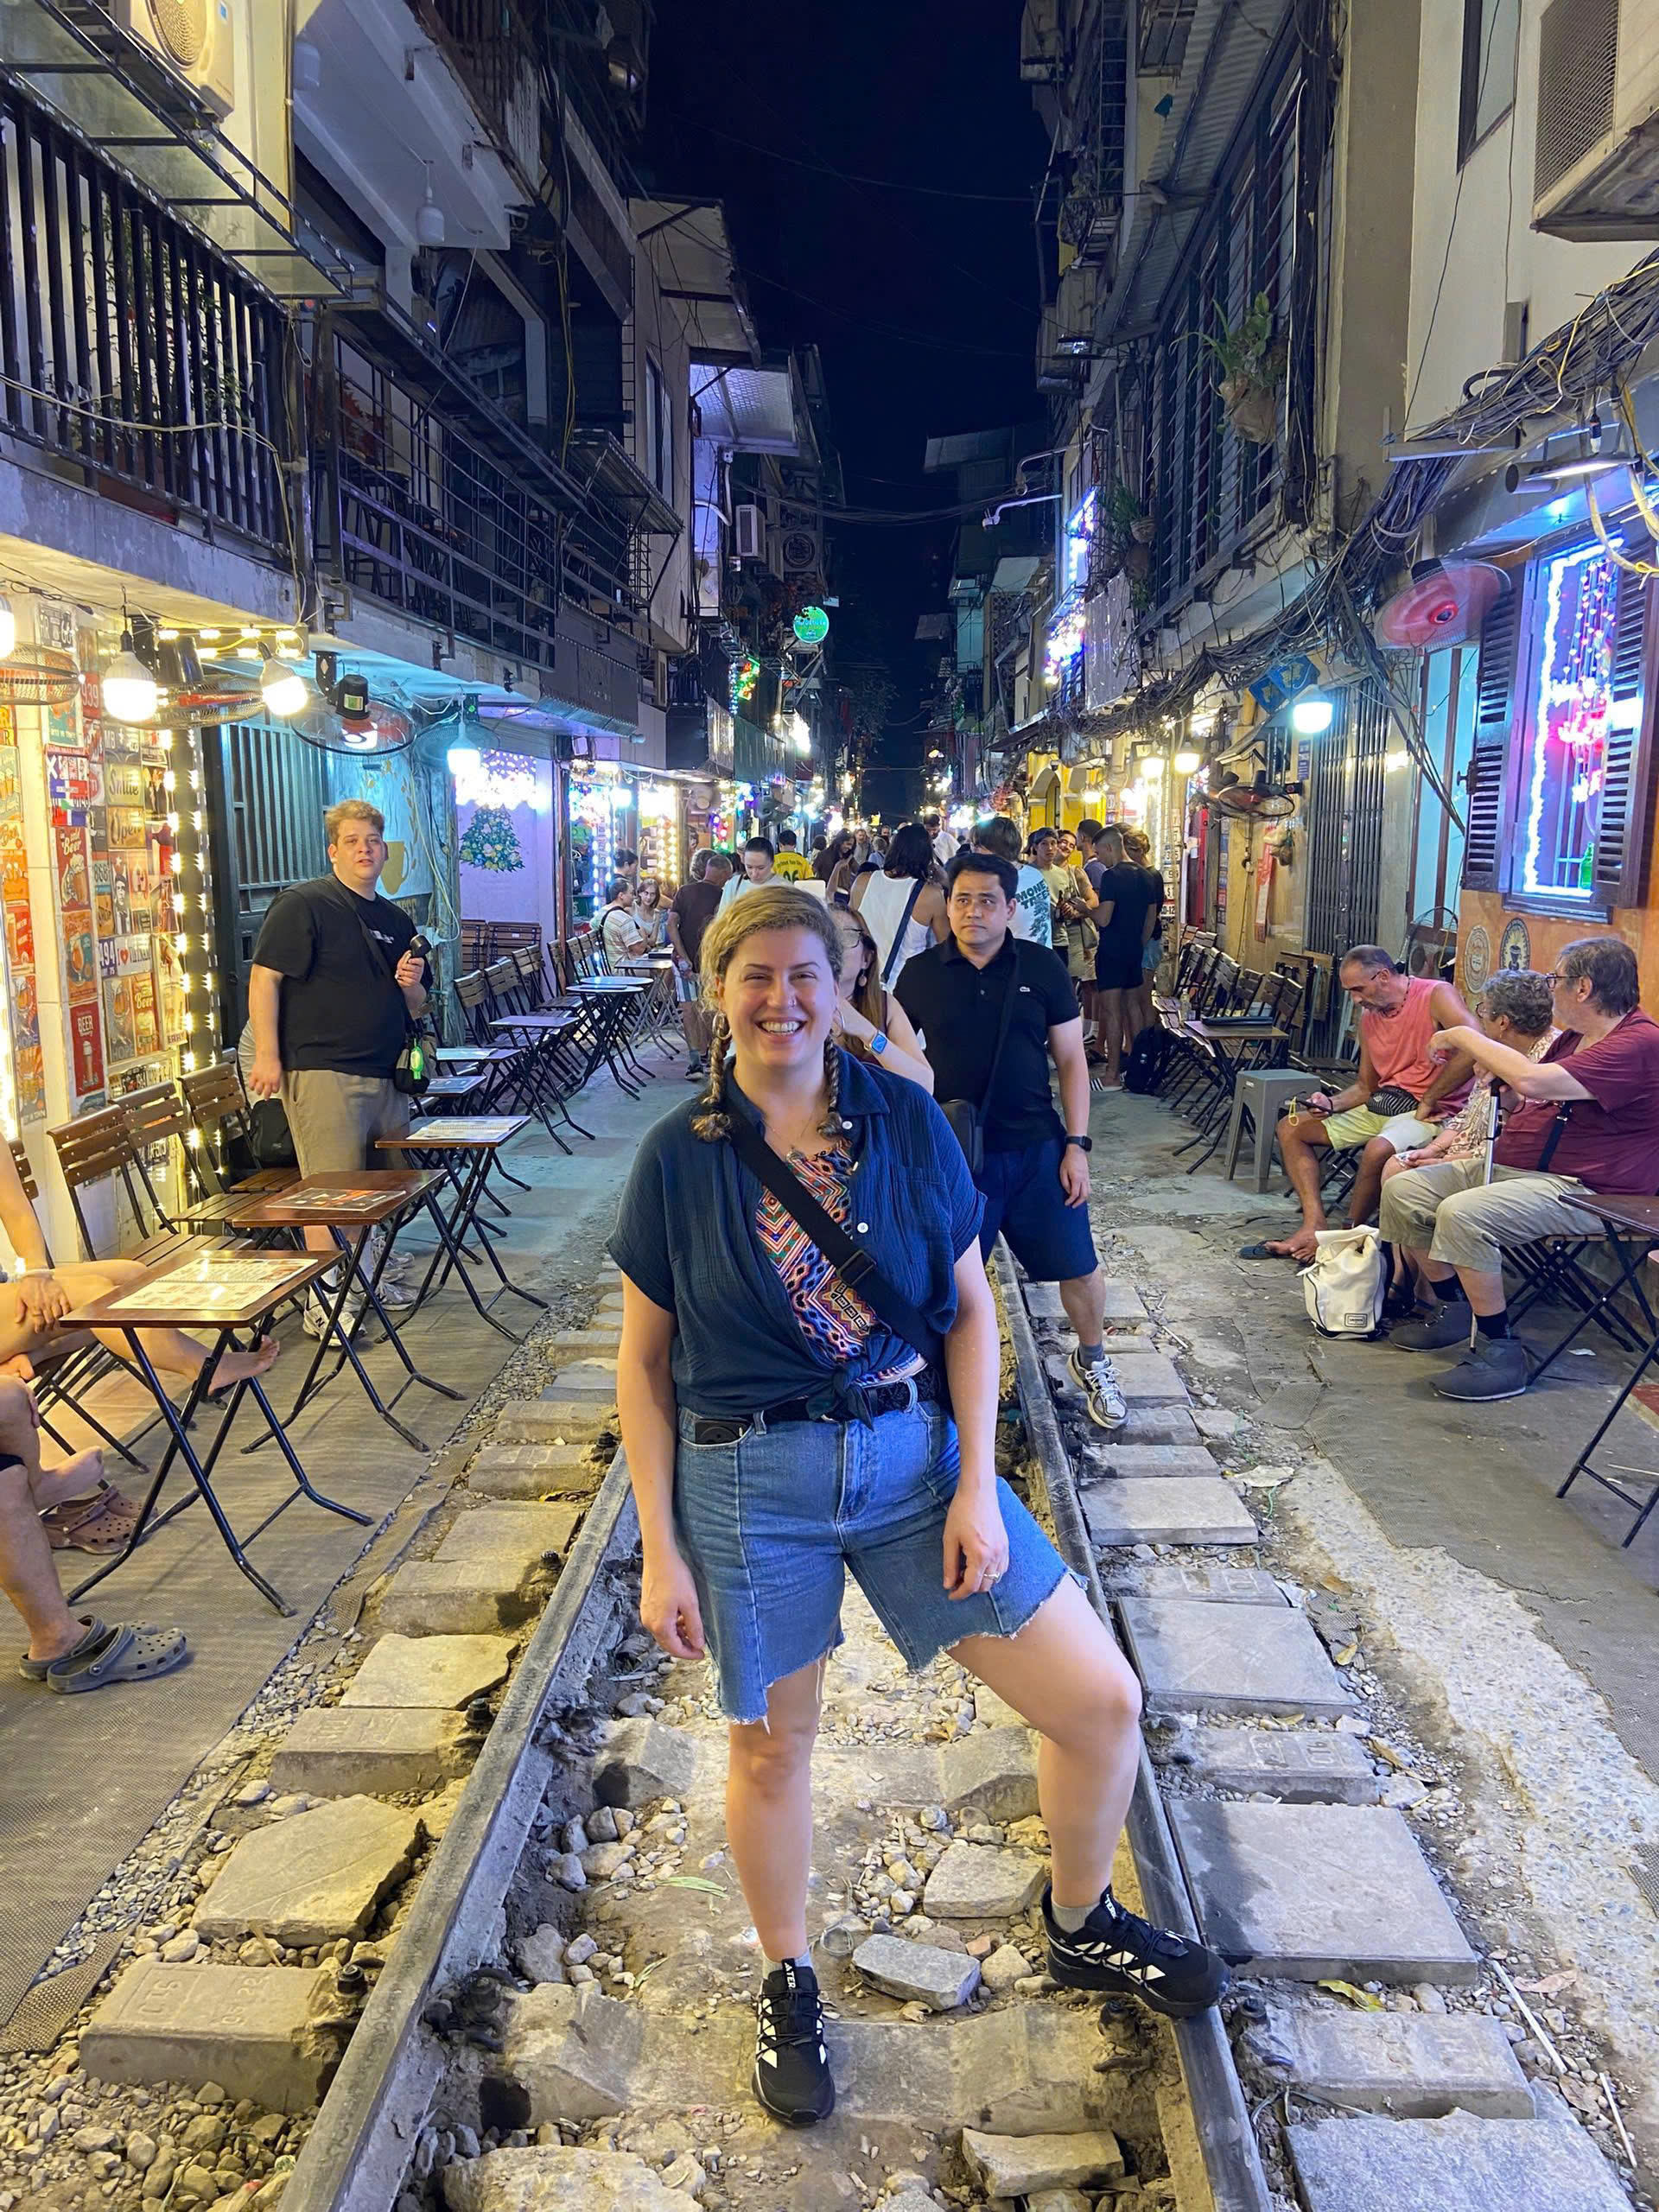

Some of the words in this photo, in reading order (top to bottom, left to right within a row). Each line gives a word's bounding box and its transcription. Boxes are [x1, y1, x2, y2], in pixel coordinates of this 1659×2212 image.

[81, 683, 99, 709] 939
[1015, 880, 1047, 903] MONE
[77, 1014, 94, 1033] BEER
